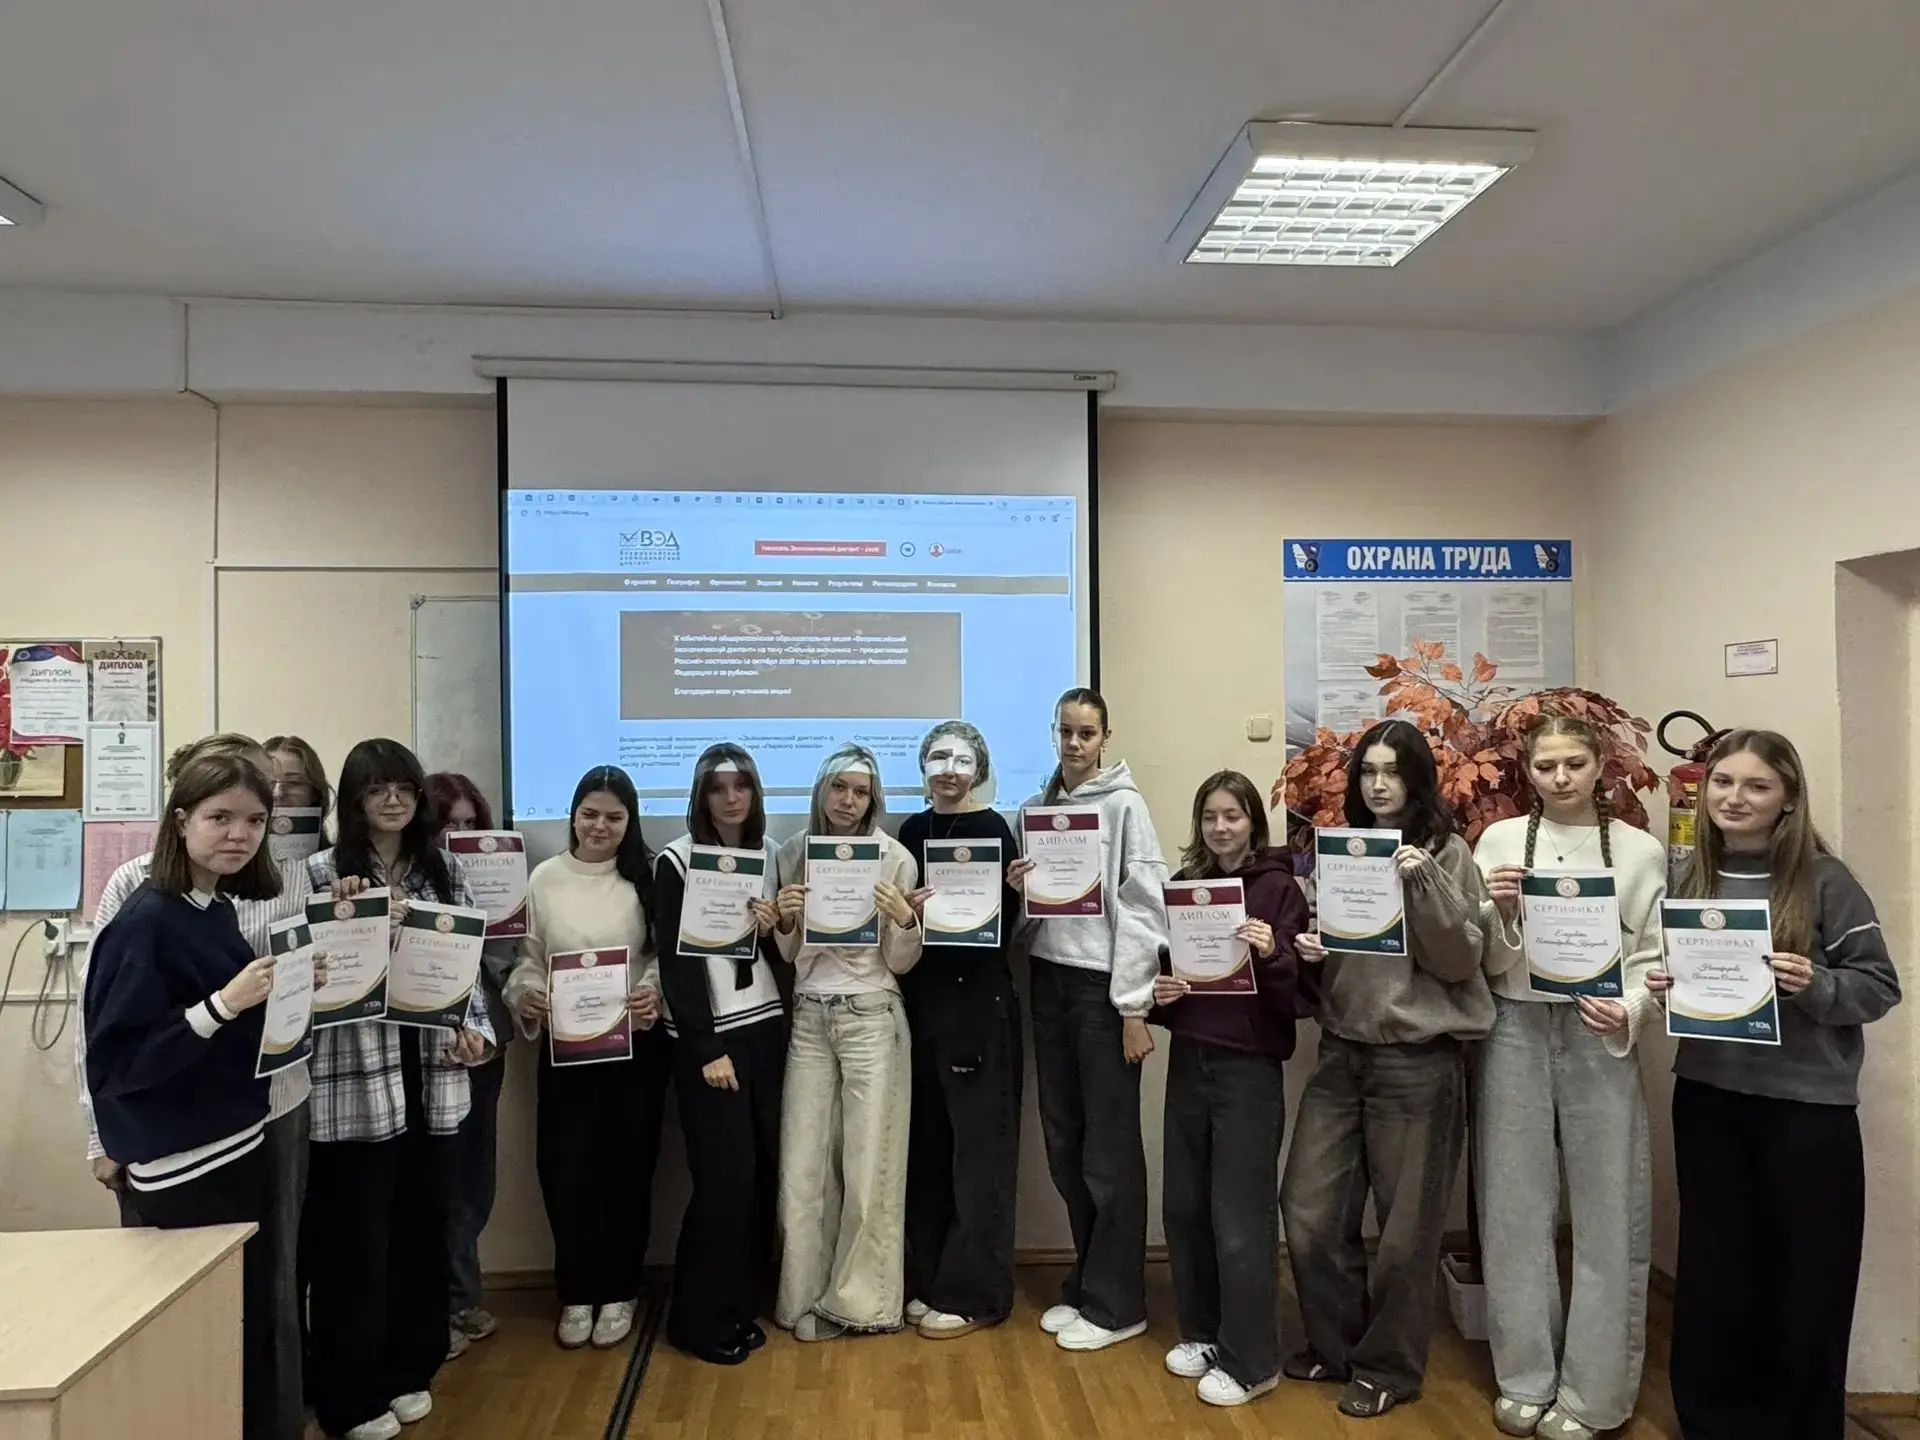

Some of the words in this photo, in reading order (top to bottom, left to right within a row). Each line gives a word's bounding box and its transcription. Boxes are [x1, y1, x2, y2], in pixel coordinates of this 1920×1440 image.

[640, 530, 680, 550] ВЭД
[1347, 546, 1435, 571] ОХРАНА
[1441, 546, 1512, 574] ТРУДА
[99, 661, 143, 671] ДИПЛОМ
[30, 668, 72, 677] ДИПЛОМ
[1038, 835, 1087, 846] ДИПЛОМ
[50, 911, 63, 919] 220
[1533, 904, 1606, 915] СЕРТИФИКАТ
[1178, 911, 1231, 921] ДИПЛОМ
[1677, 937, 1755, 948] СЕРТИФИКАТ
